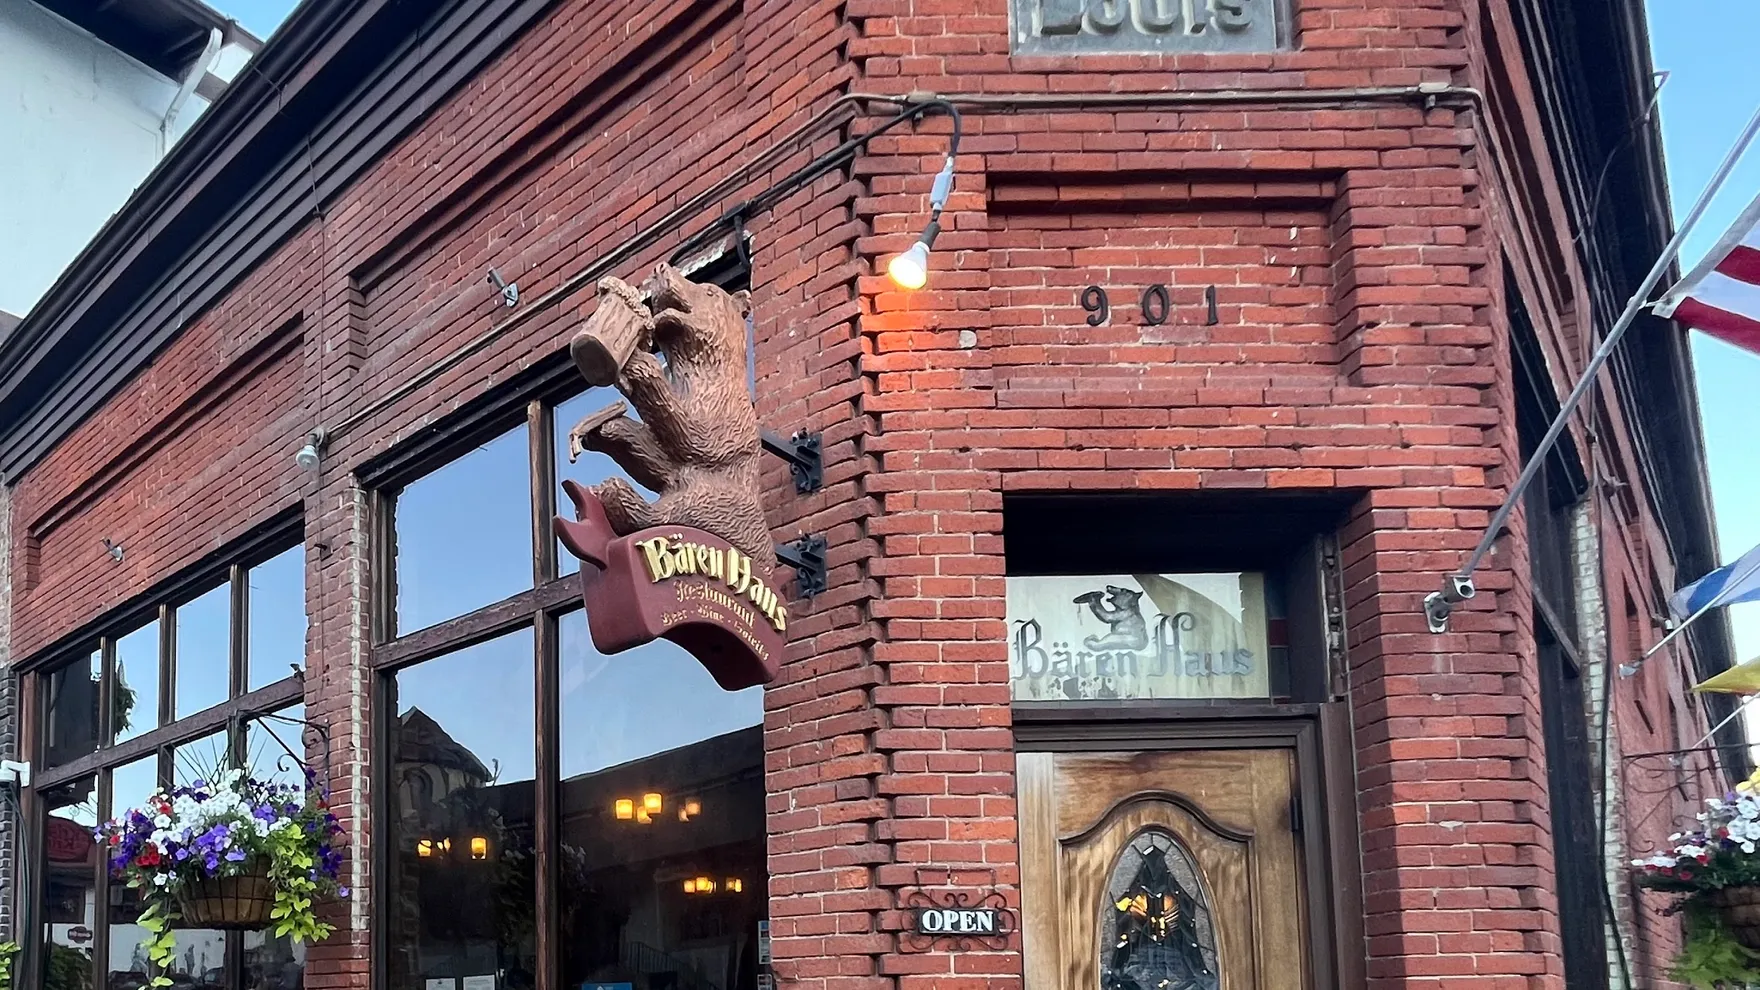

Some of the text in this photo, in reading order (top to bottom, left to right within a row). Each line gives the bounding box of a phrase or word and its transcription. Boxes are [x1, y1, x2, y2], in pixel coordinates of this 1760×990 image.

[635, 533, 787, 631] Bären Haus
[673, 580, 755, 629] Restaurant
[661, 603, 770, 660] Beer Wine Spirits
[1011, 612, 1255, 681] Bären Haus
[922, 909, 994, 932] OPEN
